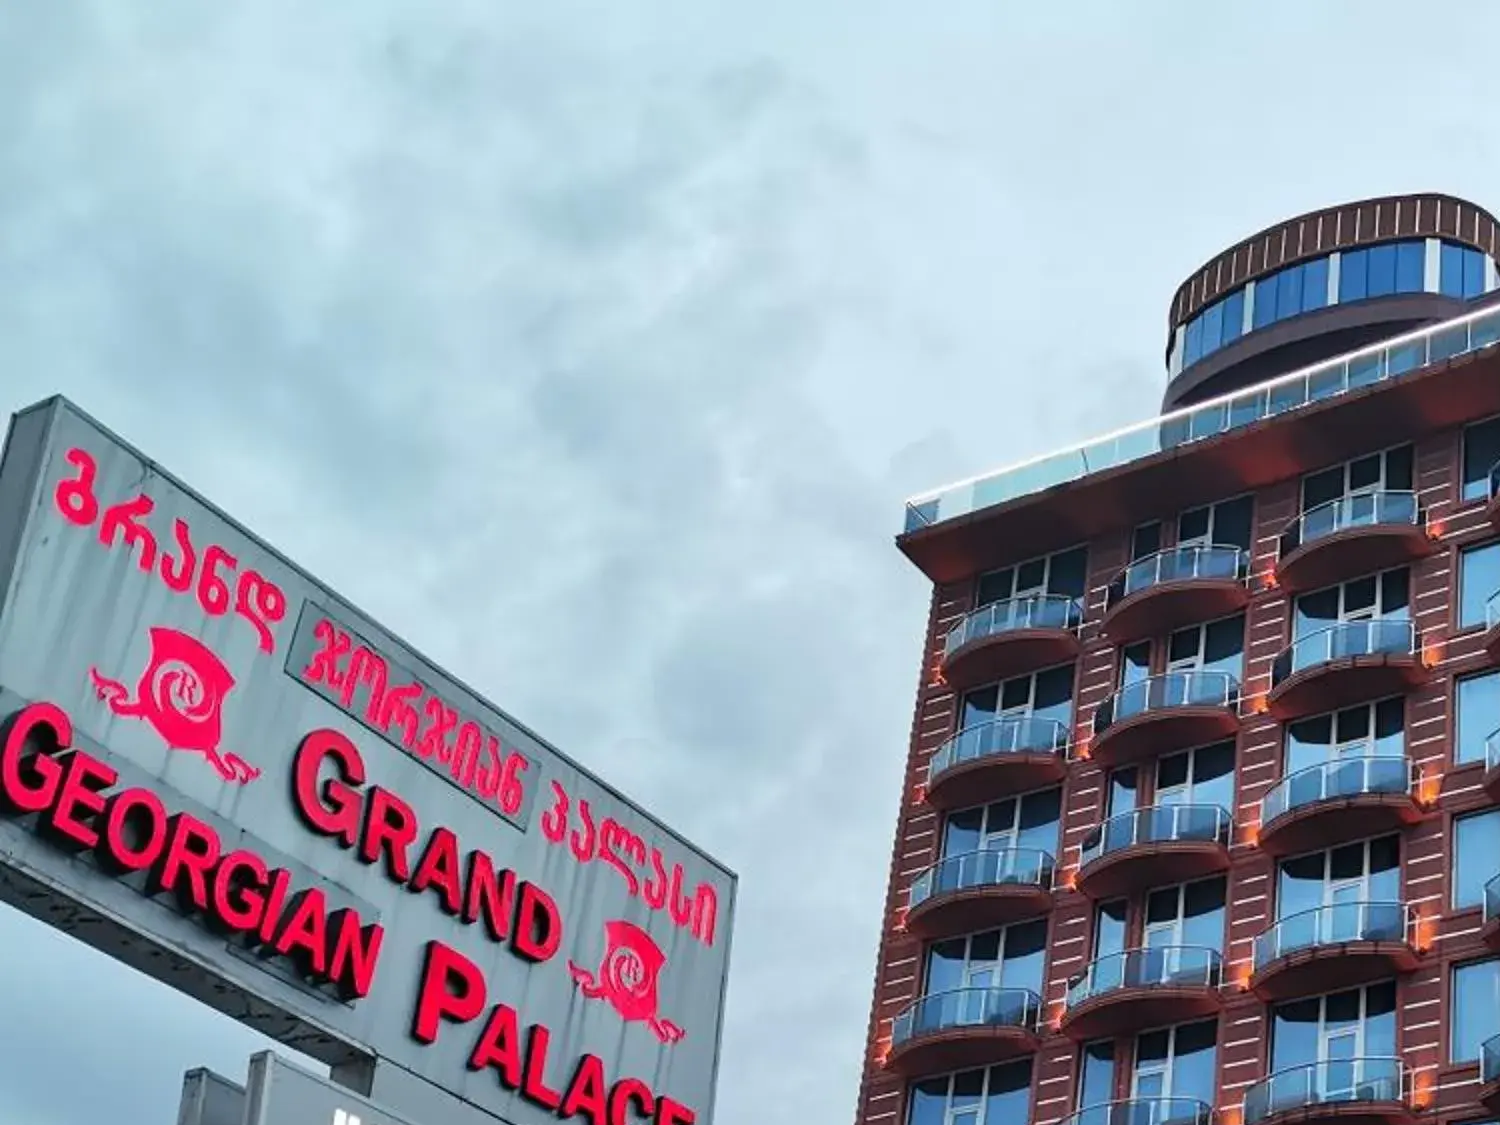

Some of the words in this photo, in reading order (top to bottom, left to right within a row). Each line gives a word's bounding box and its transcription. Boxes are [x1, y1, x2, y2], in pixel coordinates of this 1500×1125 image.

[55, 447, 287, 655] გრანდ
[303, 618, 530, 816] ჯორჯიან
[541, 779, 719, 947] პალასი
[293, 727, 563, 962] GRAND
[2, 701, 385, 999] GEORGIAN
